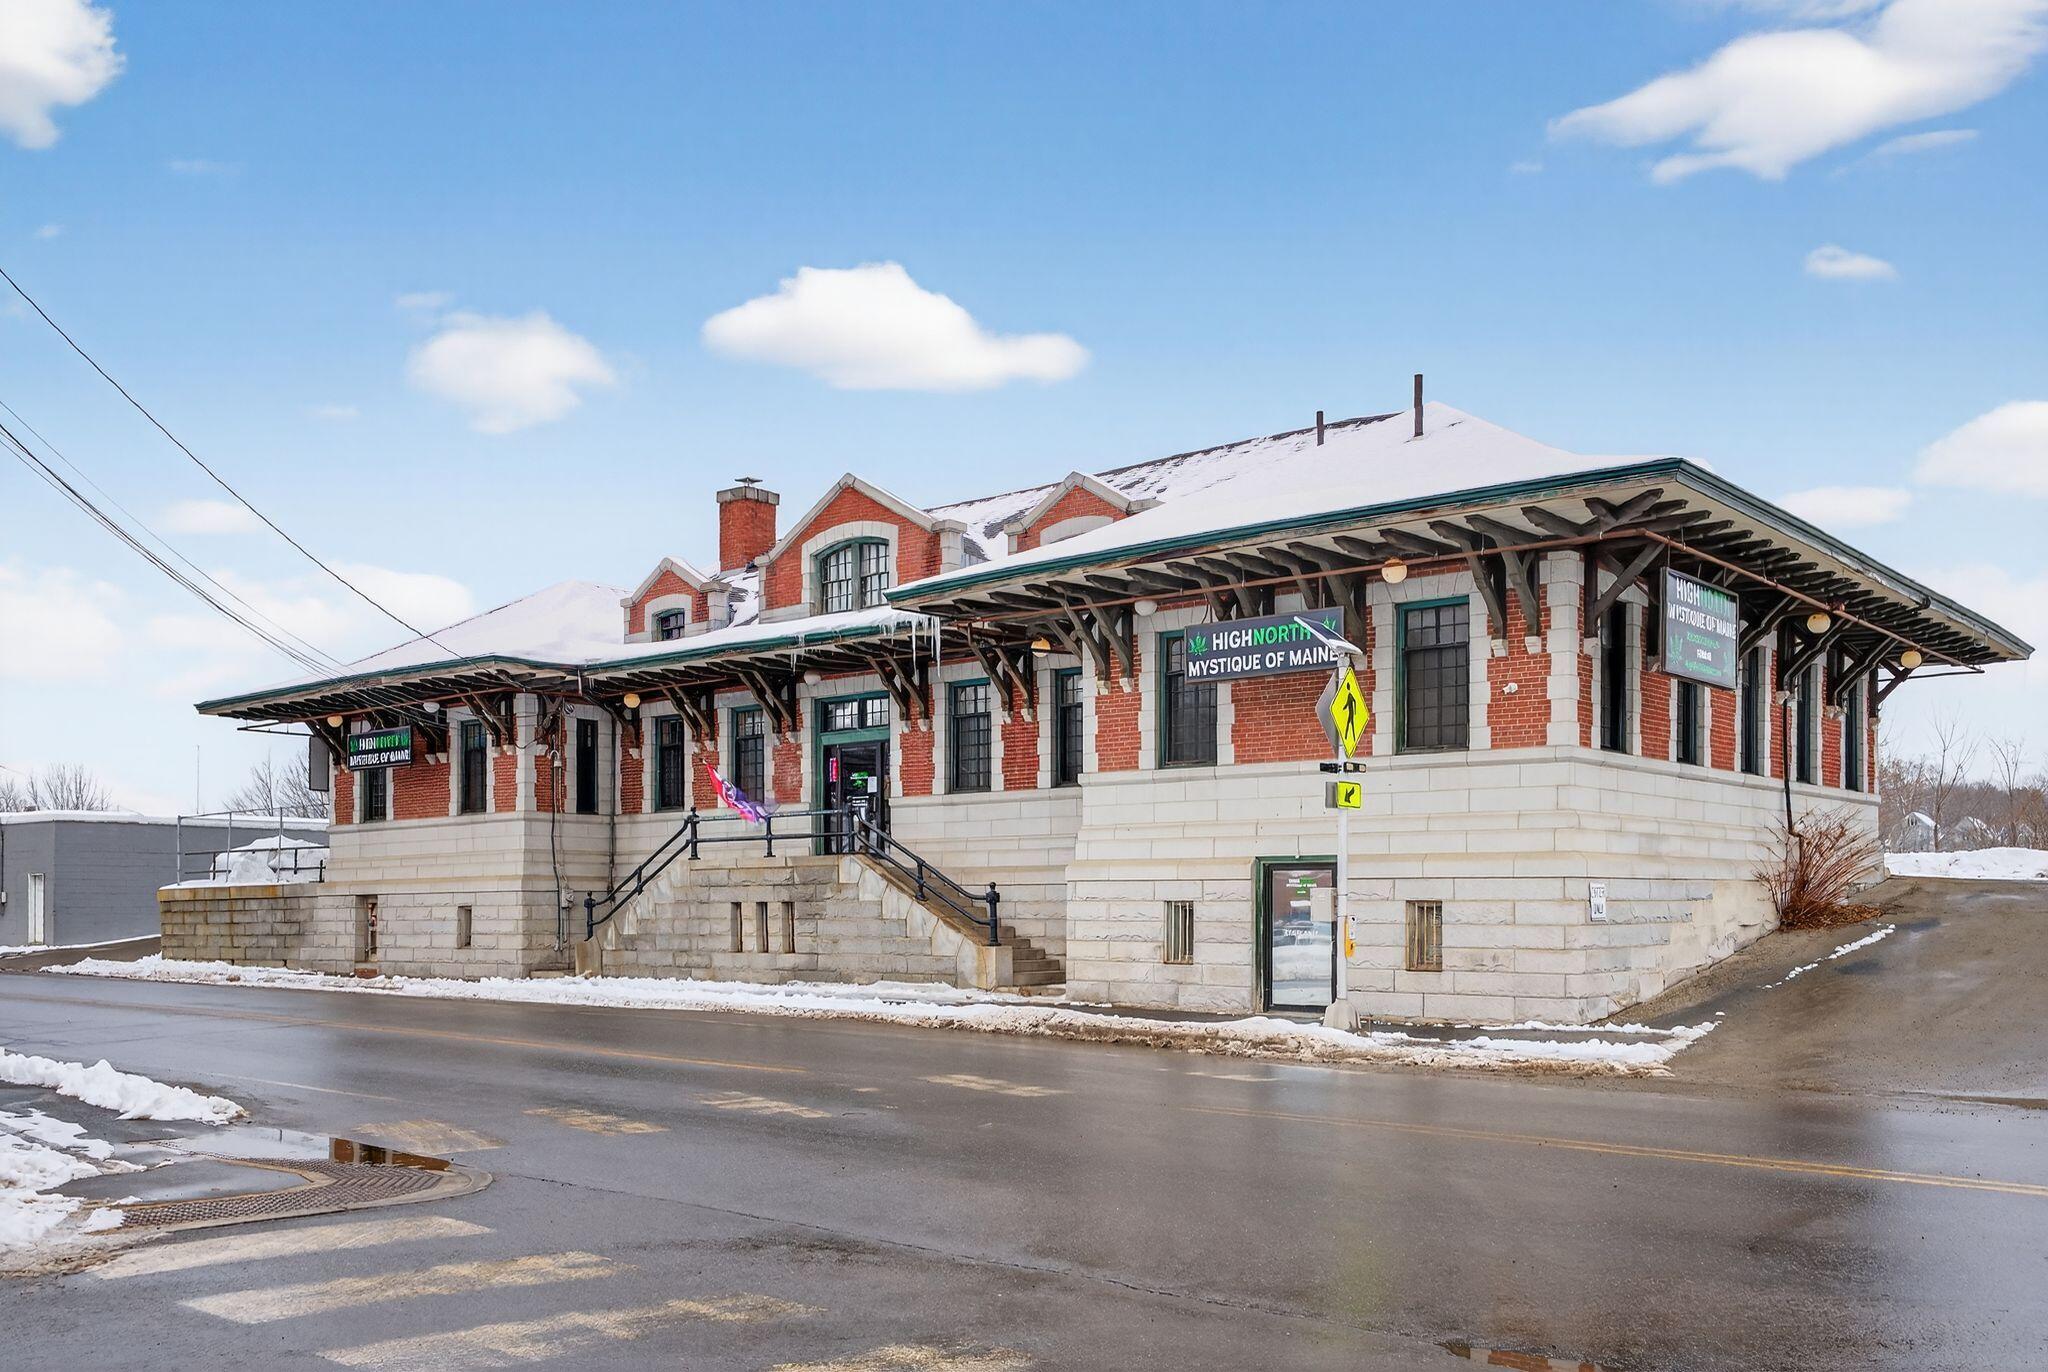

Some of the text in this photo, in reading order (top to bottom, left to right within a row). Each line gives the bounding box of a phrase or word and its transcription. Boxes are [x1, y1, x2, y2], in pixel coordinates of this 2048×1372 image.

[1212, 623, 1311, 650] HIGHNORTH
[1188, 645, 1339, 677] MYSTIQUE OF MAINE
